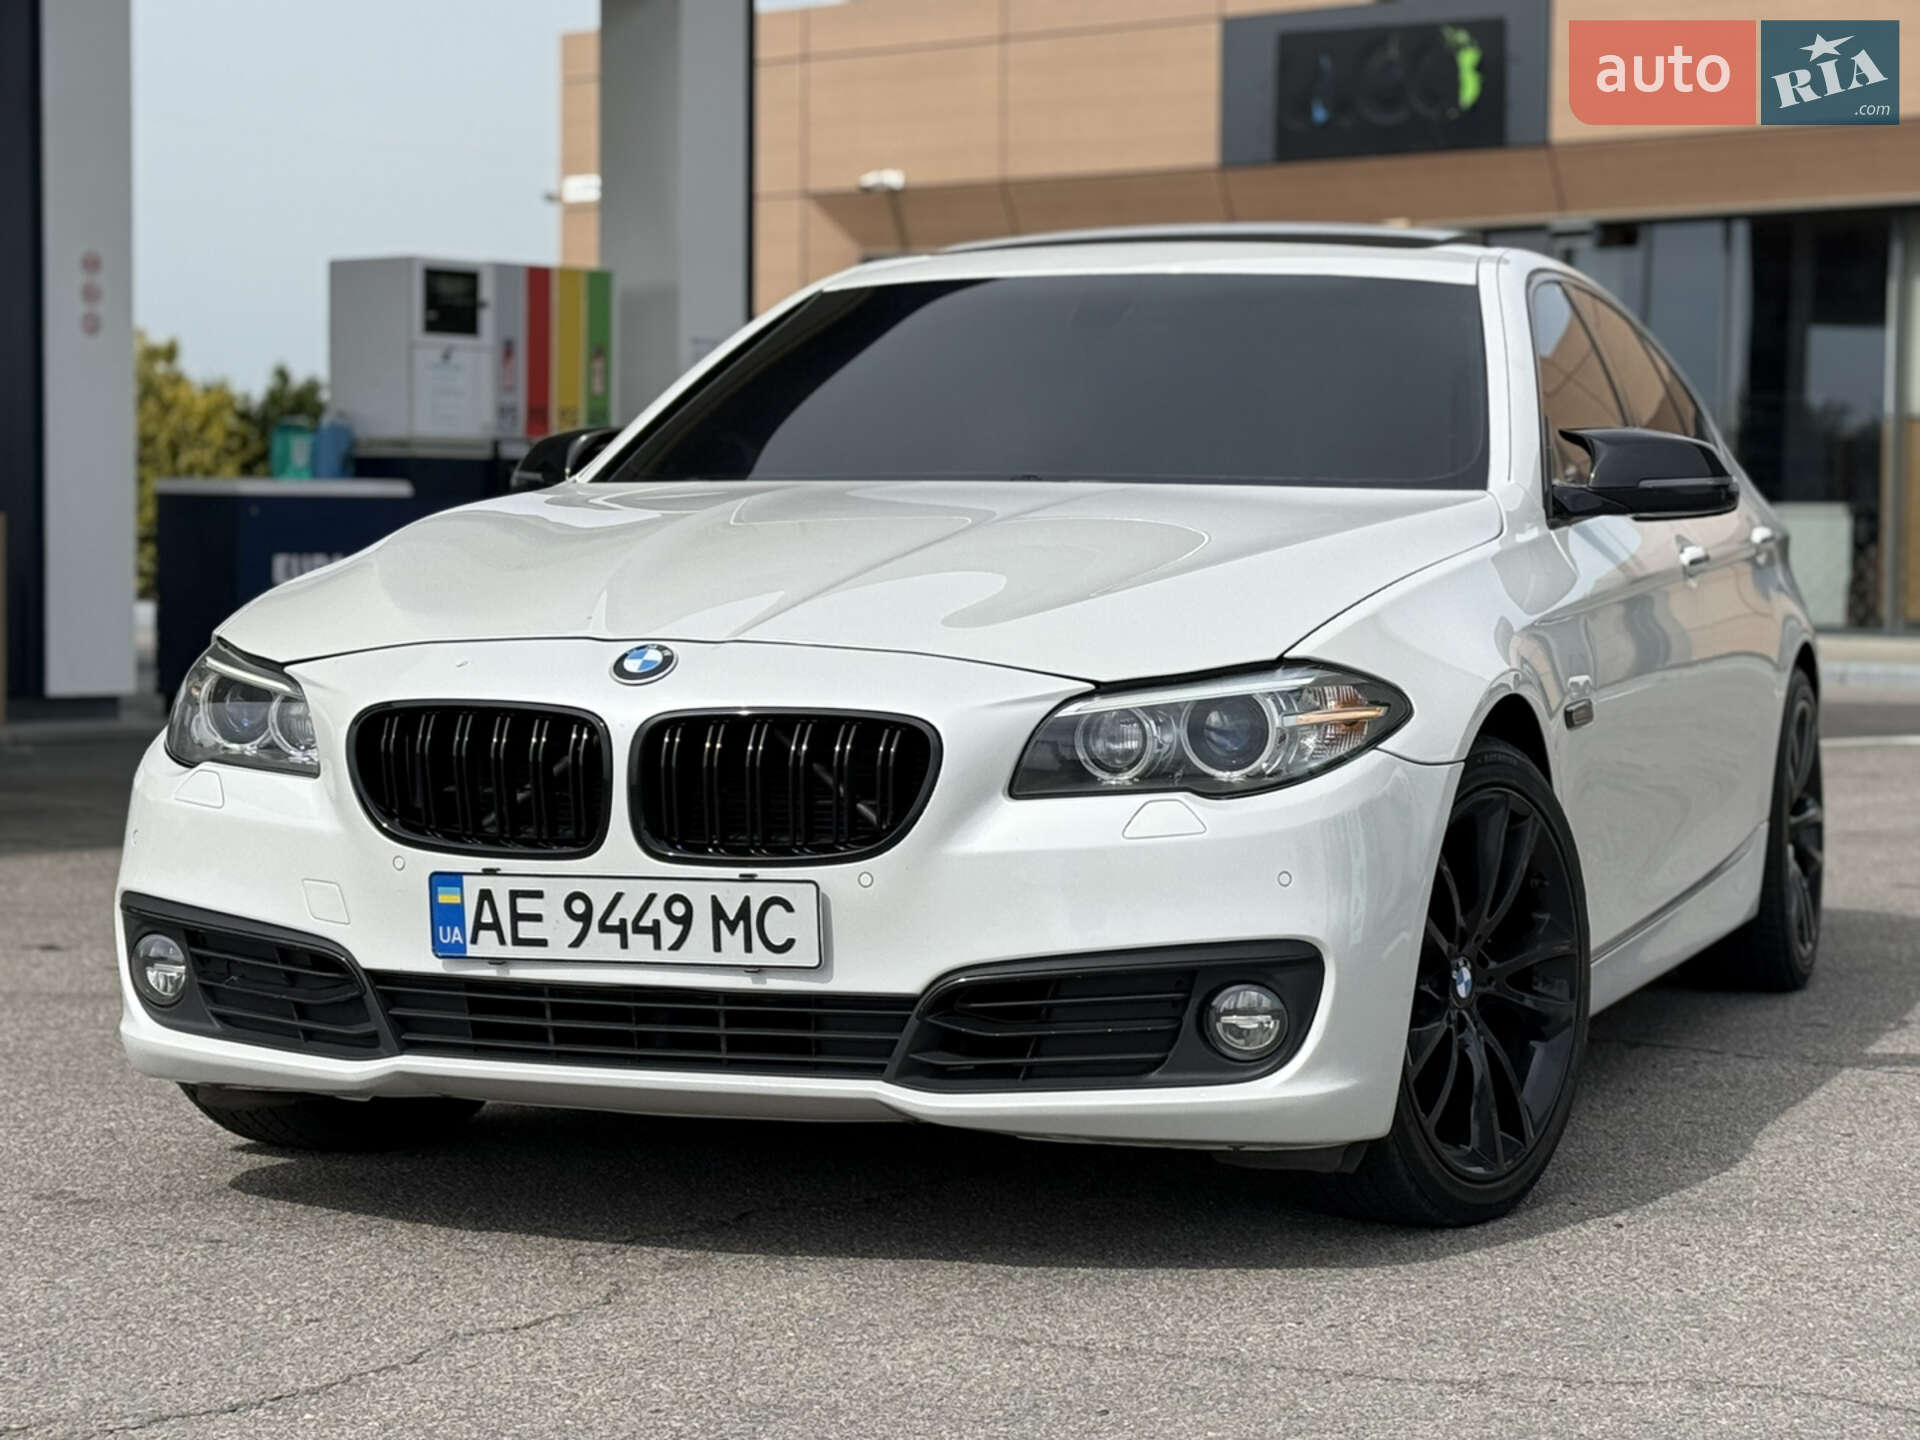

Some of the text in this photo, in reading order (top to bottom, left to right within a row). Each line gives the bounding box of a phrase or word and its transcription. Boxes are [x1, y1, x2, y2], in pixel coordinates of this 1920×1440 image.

[438, 925, 464, 945] UA
[469, 888, 796, 955] AE 9449 MC
